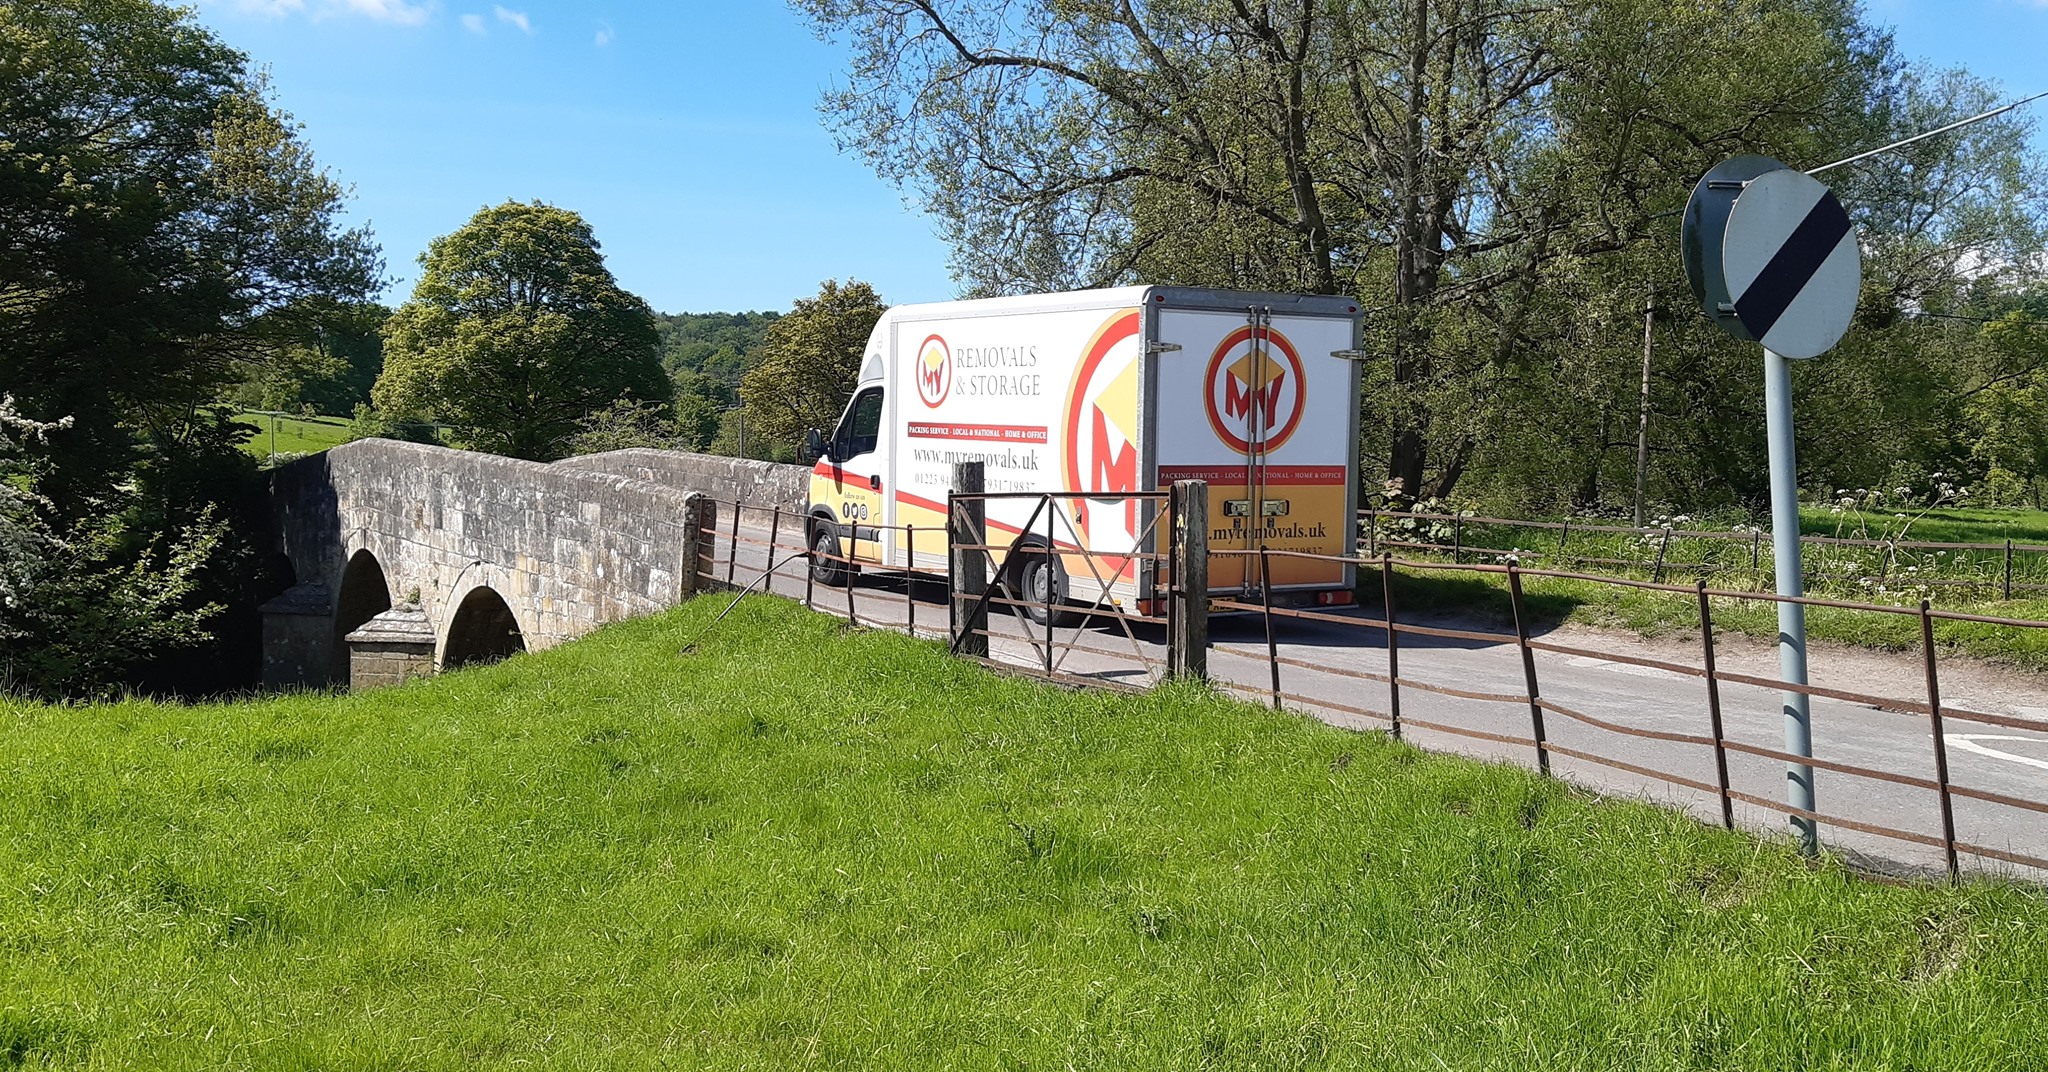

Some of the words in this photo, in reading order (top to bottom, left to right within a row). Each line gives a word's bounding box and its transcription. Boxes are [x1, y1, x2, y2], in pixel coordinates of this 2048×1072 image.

[957, 345, 1037, 368] REMOVALS
[922, 358, 945, 397] MY
[955, 375, 966, 396] &
[970, 374, 1041, 396] STORAGE
[1225, 368, 1287, 434] MY
[909, 426, 930, 434] PACKING
[930, 427, 949, 435] SERVICE
[952, 428, 968, 436] LOCAL
[974, 428, 1000, 437] NATIONAL
[1004, 430, 1020, 438] HOME
[1027, 431, 1047, 440] OFFICE
